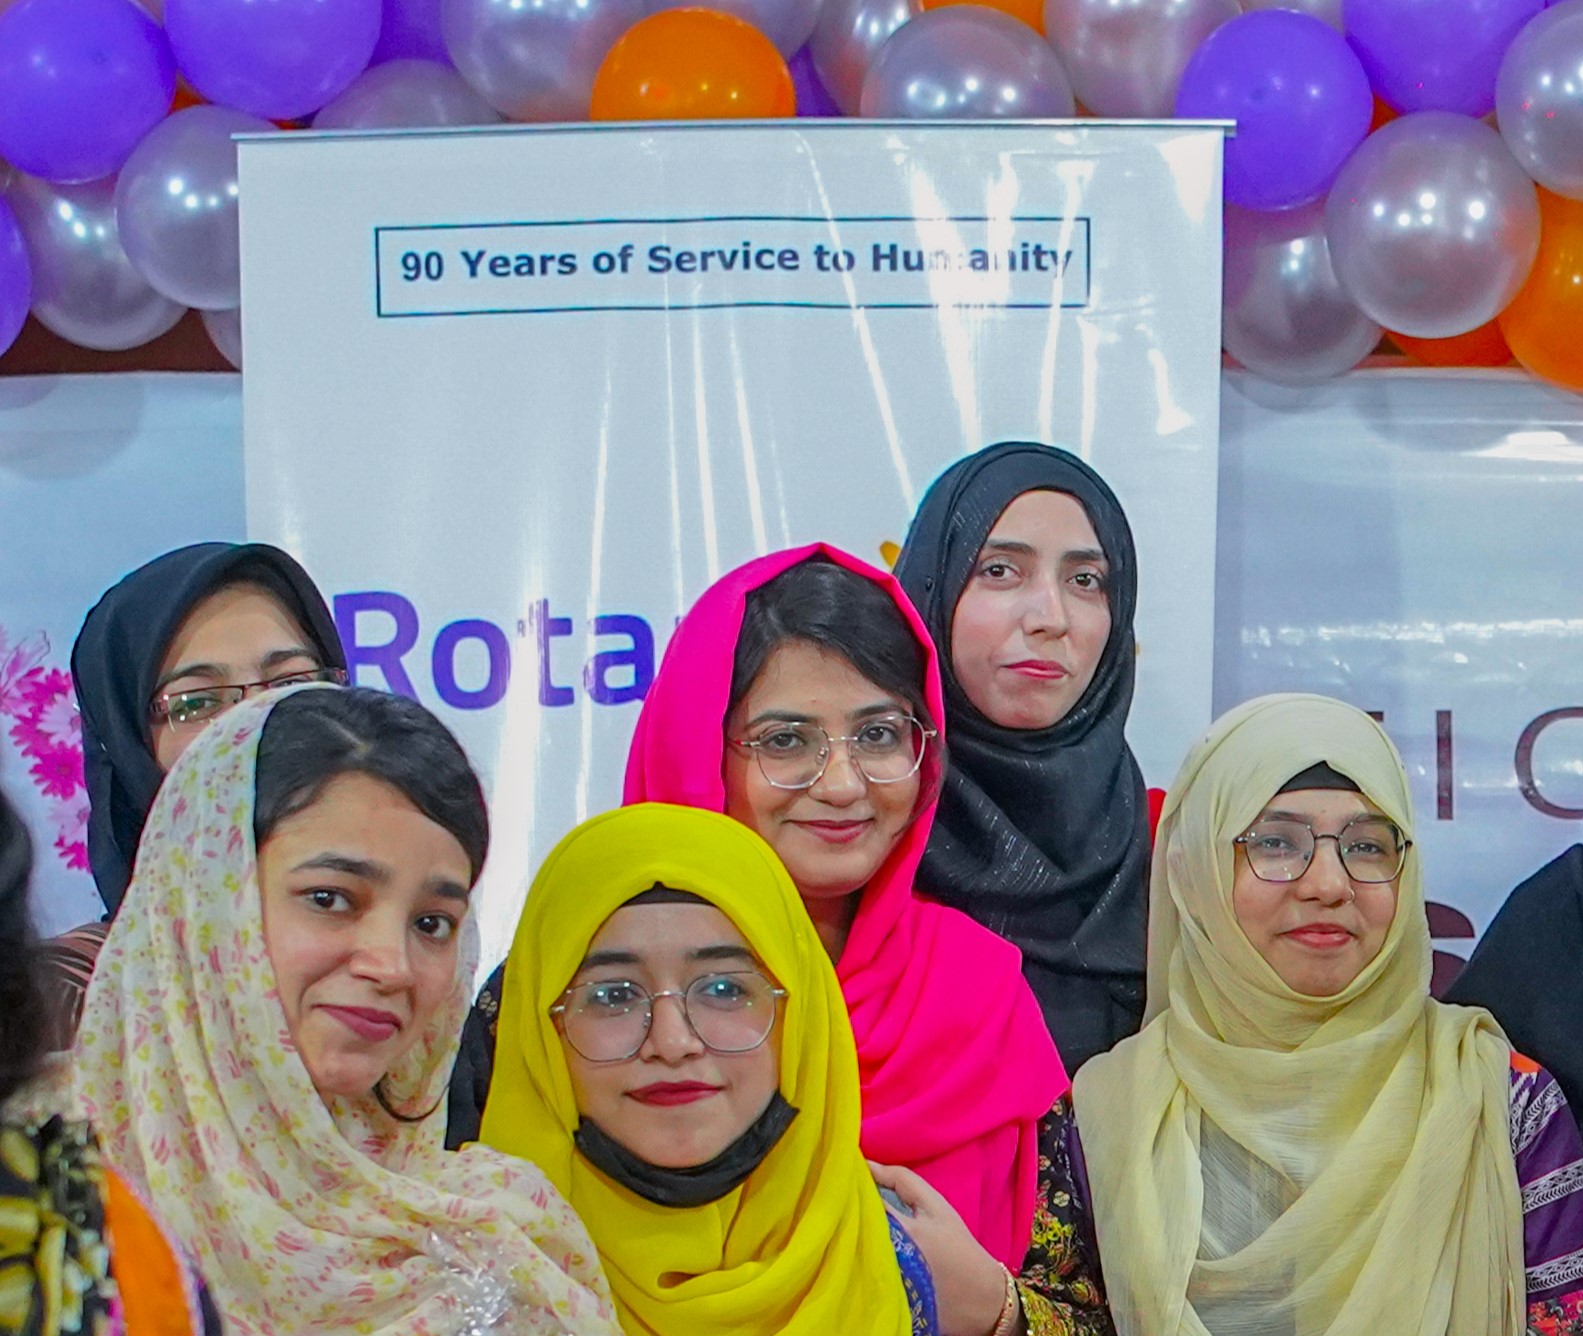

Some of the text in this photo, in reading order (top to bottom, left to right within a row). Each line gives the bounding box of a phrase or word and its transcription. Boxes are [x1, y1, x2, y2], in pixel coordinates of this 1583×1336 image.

[401, 251, 444, 281] 90
[461, 248, 577, 278] Years
[592, 244, 633, 275] of
[648, 242, 801, 274] Service
[814, 244, 854, 272] to
